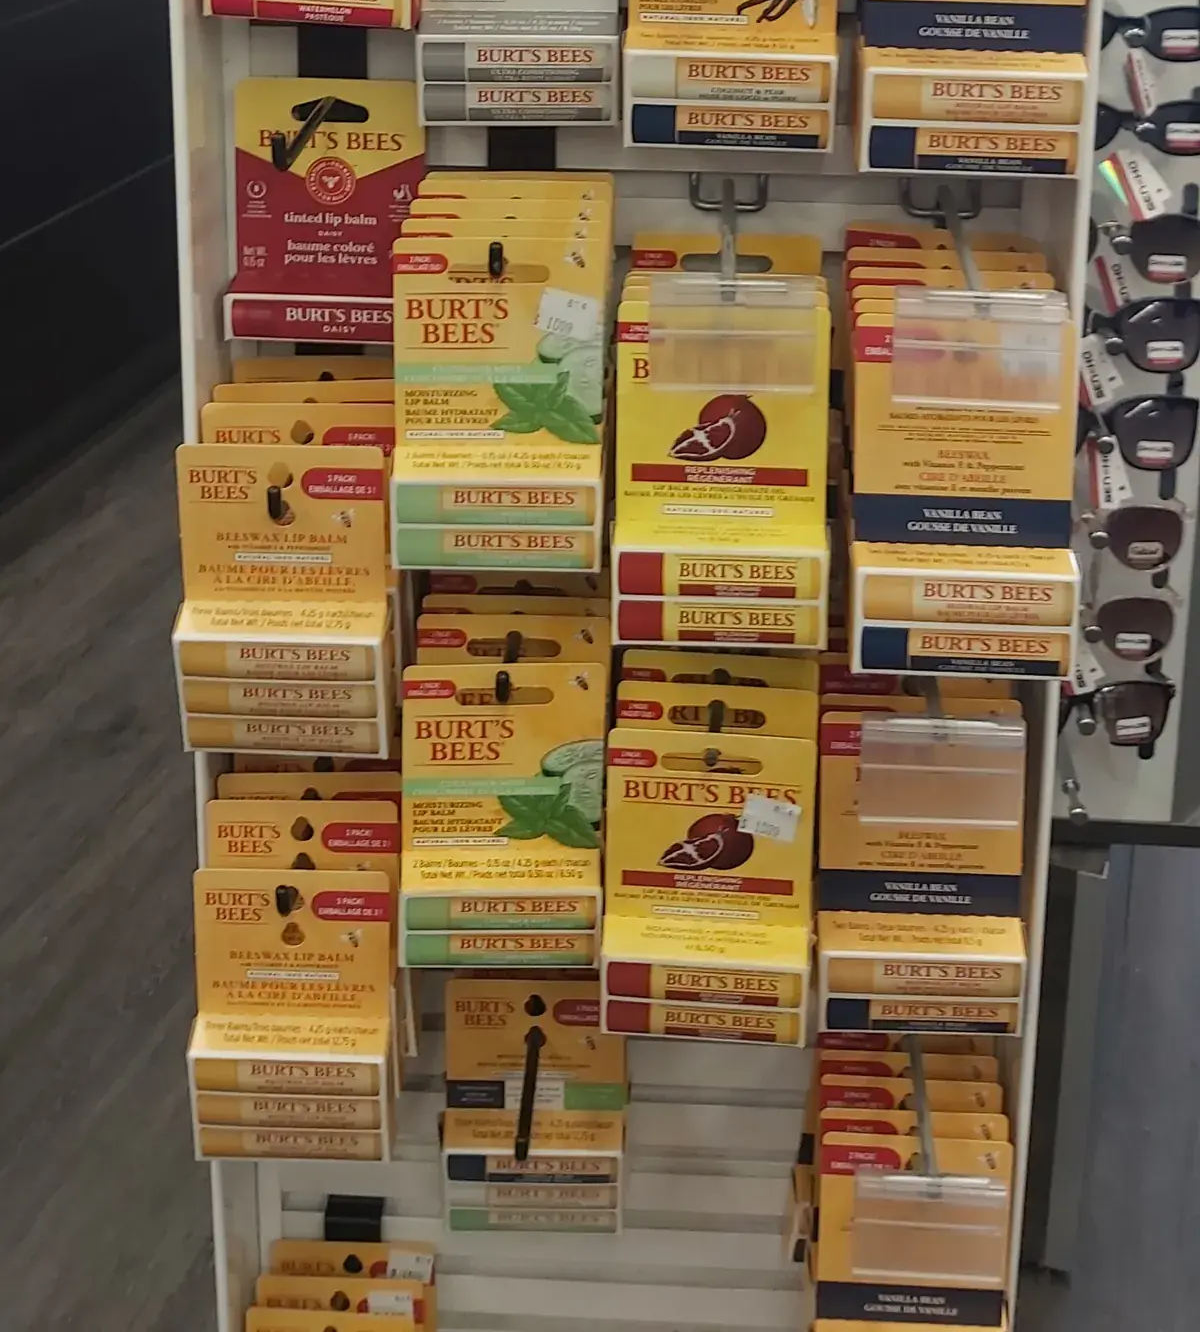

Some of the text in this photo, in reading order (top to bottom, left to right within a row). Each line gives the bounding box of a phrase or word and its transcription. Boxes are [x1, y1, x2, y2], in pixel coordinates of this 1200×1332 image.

[299, 5, 352, 14] WATERMELON
[935, 14, 1015, 26] VANILLA BEAN
[919, 28, 1031, 40] GOUSSE DE VANILLE
[477, 50, 594, 63] BURT'S BEES
[688, 64, 811, 81] BURT'S BEES
[346, 132, 404, 151] BEES
[284, 211, 377, 226] tinted lip balm
[287, 239, 375, 253] baume coloré
[284, 252, 378, 265] pour les lèvres
[406, 298, 509, 319] BURT'S
[322, 325, 356, 334] DAISY
[421, 323, 495, 344] BEES
[216, 429, 281, 444] BURT'S
[188, 469, 258, 485] BURT'S
[200, 486, 249, 500] BEES
[454, 491, 575, 505] BURT'S BEES
[922, 508, 1003, 520] VANILLA BEAN
[907, 522, 1018, 534] GOUSSE DE VANILLE
[216, 532, 347, 544] BEESWAX LIP BALM
[454, 535, 575, 549] BURT'S BEES
[679, 563, 797, 580] BURT'S BEES
[923, 583, 1054, 602] BURT'S BEES
[415, 720, 514, 739] BURT'S
[430, 742, 500, 761] BEES
[217, 825, 281, 839] BURT'S
[228, 840, 273, 853] BEES
[205, 892, 270, 907] BURT'S
[461, 901, 578, 913] BURT'S BEES
[216, 908, 262, 922] BEES
[883, 964, 1003, 979] BURT'S BEES
[666, 973, 778, 991] BURT'S BEES
